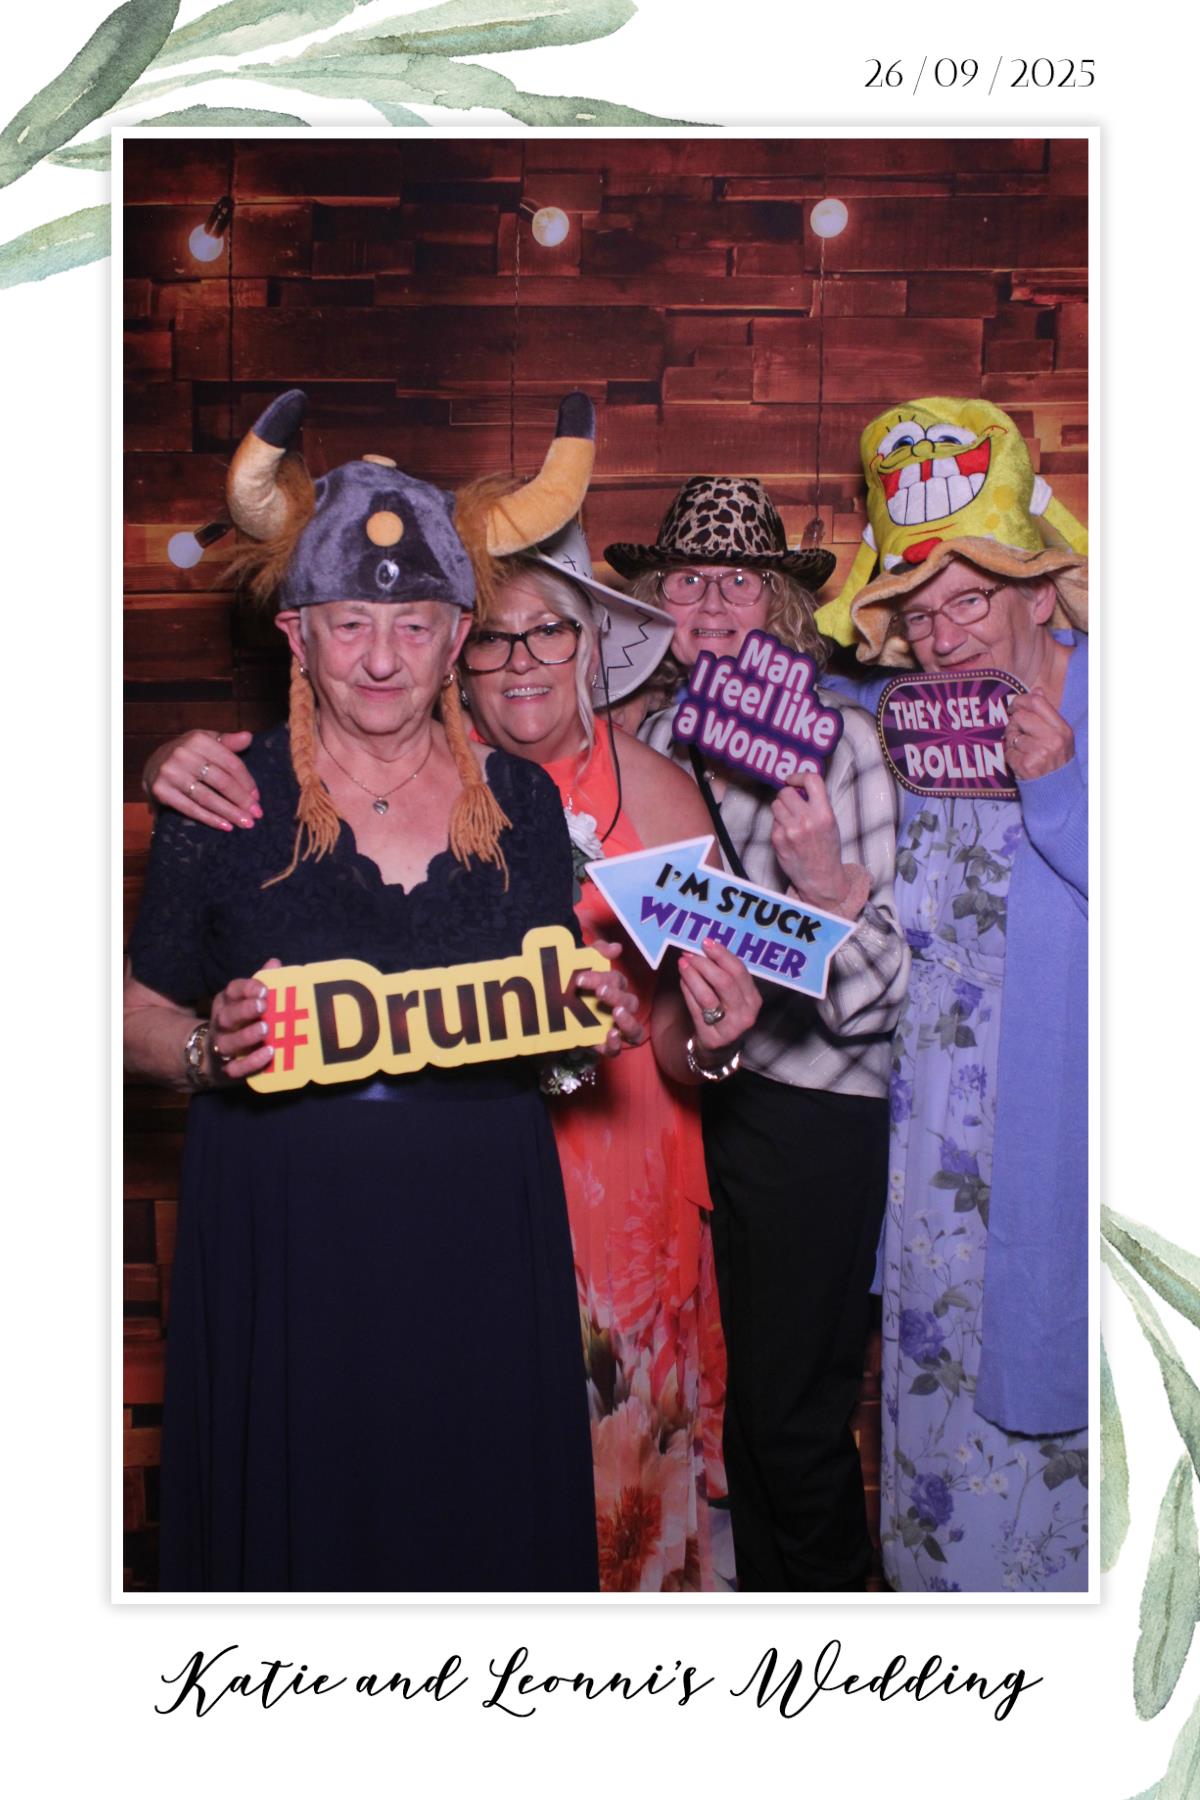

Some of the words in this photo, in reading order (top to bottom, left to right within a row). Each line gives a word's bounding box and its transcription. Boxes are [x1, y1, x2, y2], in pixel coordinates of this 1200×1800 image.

[740, 637, 810, 692] Man
[677, 705, 699, 735] a
[693, 659, 709, 692] I
[708, 664, 775, 720] feel
[772, 690, 836, 747] like
[888, 699, 943, 731] THEY
[946, 696, 985, 731] SEE
[988, 693, 1017, 728] M
[903, 741, 1009, 779] ROLLIN
[640, 895, 737, 951] WITH
[735, 931, 808, 979] HER
[655, 862, 711, 903] I'M
[716, 885, 822, 944] STUCK
[263, 945, 603, 1074] #Drunk
